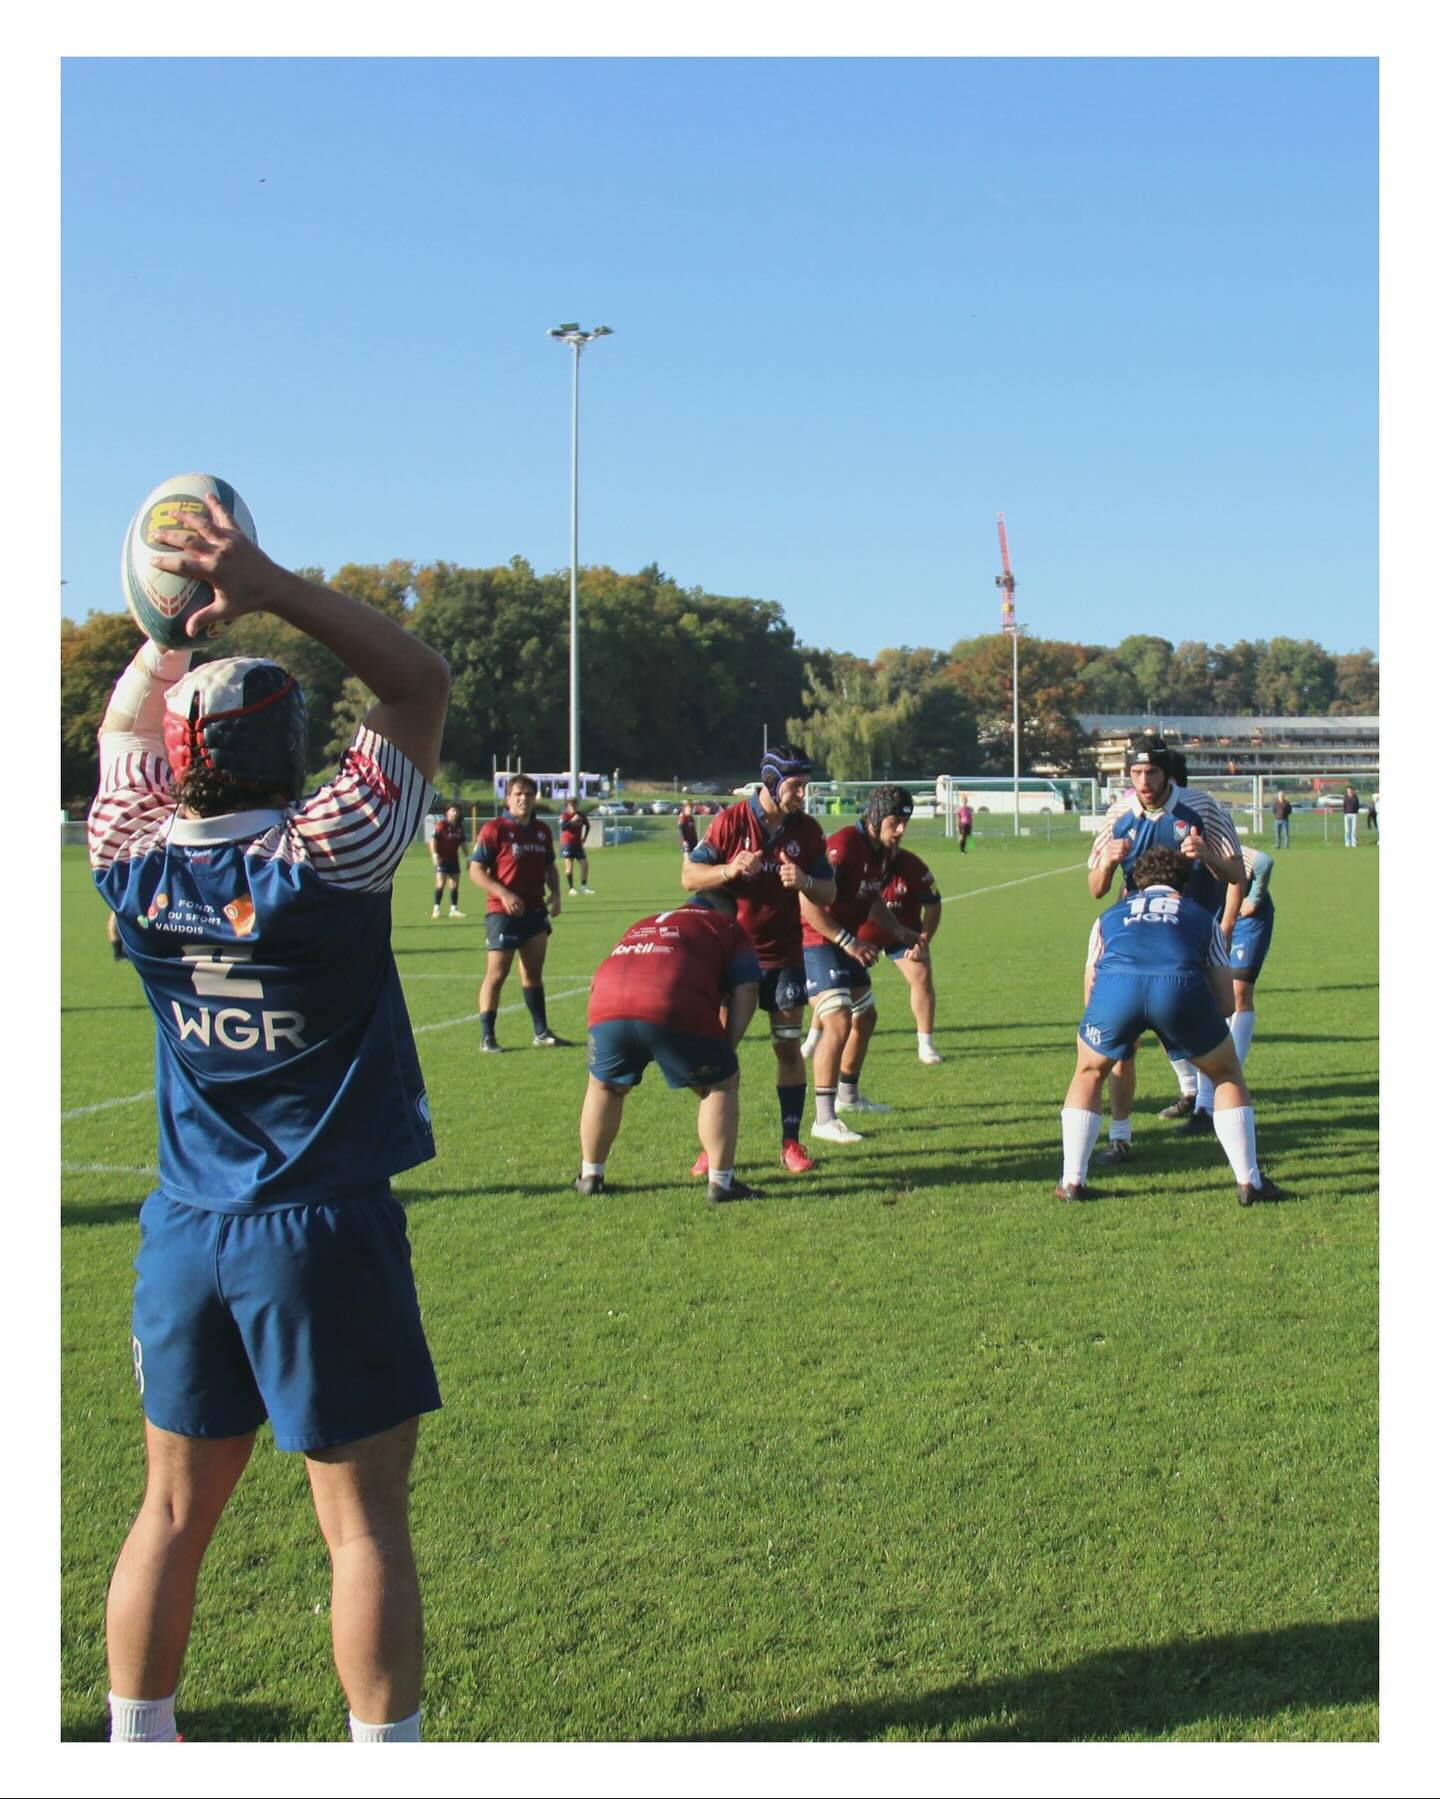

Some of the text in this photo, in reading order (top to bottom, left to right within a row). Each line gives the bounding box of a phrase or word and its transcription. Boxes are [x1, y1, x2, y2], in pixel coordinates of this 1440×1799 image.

[1126, 896, 1181, 915] 16
[168, 911, 222, 926] DU SPORT
[1123, 912, 1180, 927] WGR
[155, 922, 204, 934] VAUDOIS
[171, 1000, 307, 1051] WGR
